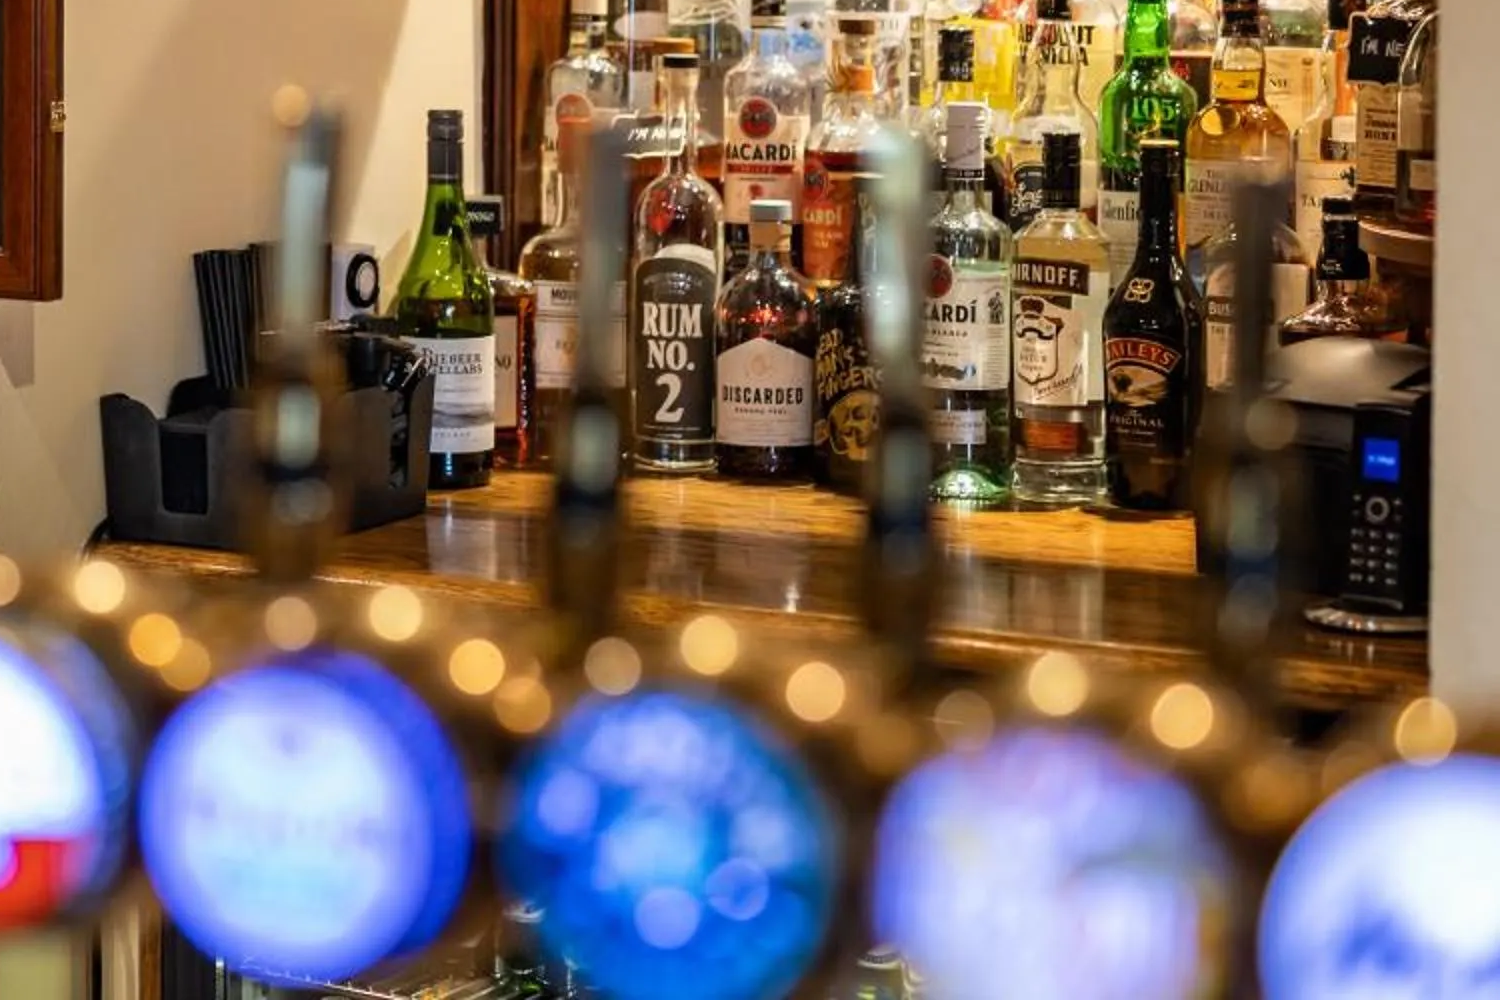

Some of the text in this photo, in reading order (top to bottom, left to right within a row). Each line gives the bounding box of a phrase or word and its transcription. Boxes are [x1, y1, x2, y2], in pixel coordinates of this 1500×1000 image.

[1019, 47, 1089, 66] VNILIA
[1385, 39, 1407, 57] NE
[804, 205, 842, 226] CARDÍ
[642, 302, 703, 337] RUM
[924, 300, 977, 324] ARDÍ
[647, 341, 696, 371] NO.
[1109, 342, 1172, 365] AILEYS
[655, 374, 685, 423] 2
[722, 386, 804, 405] DISCARDED
